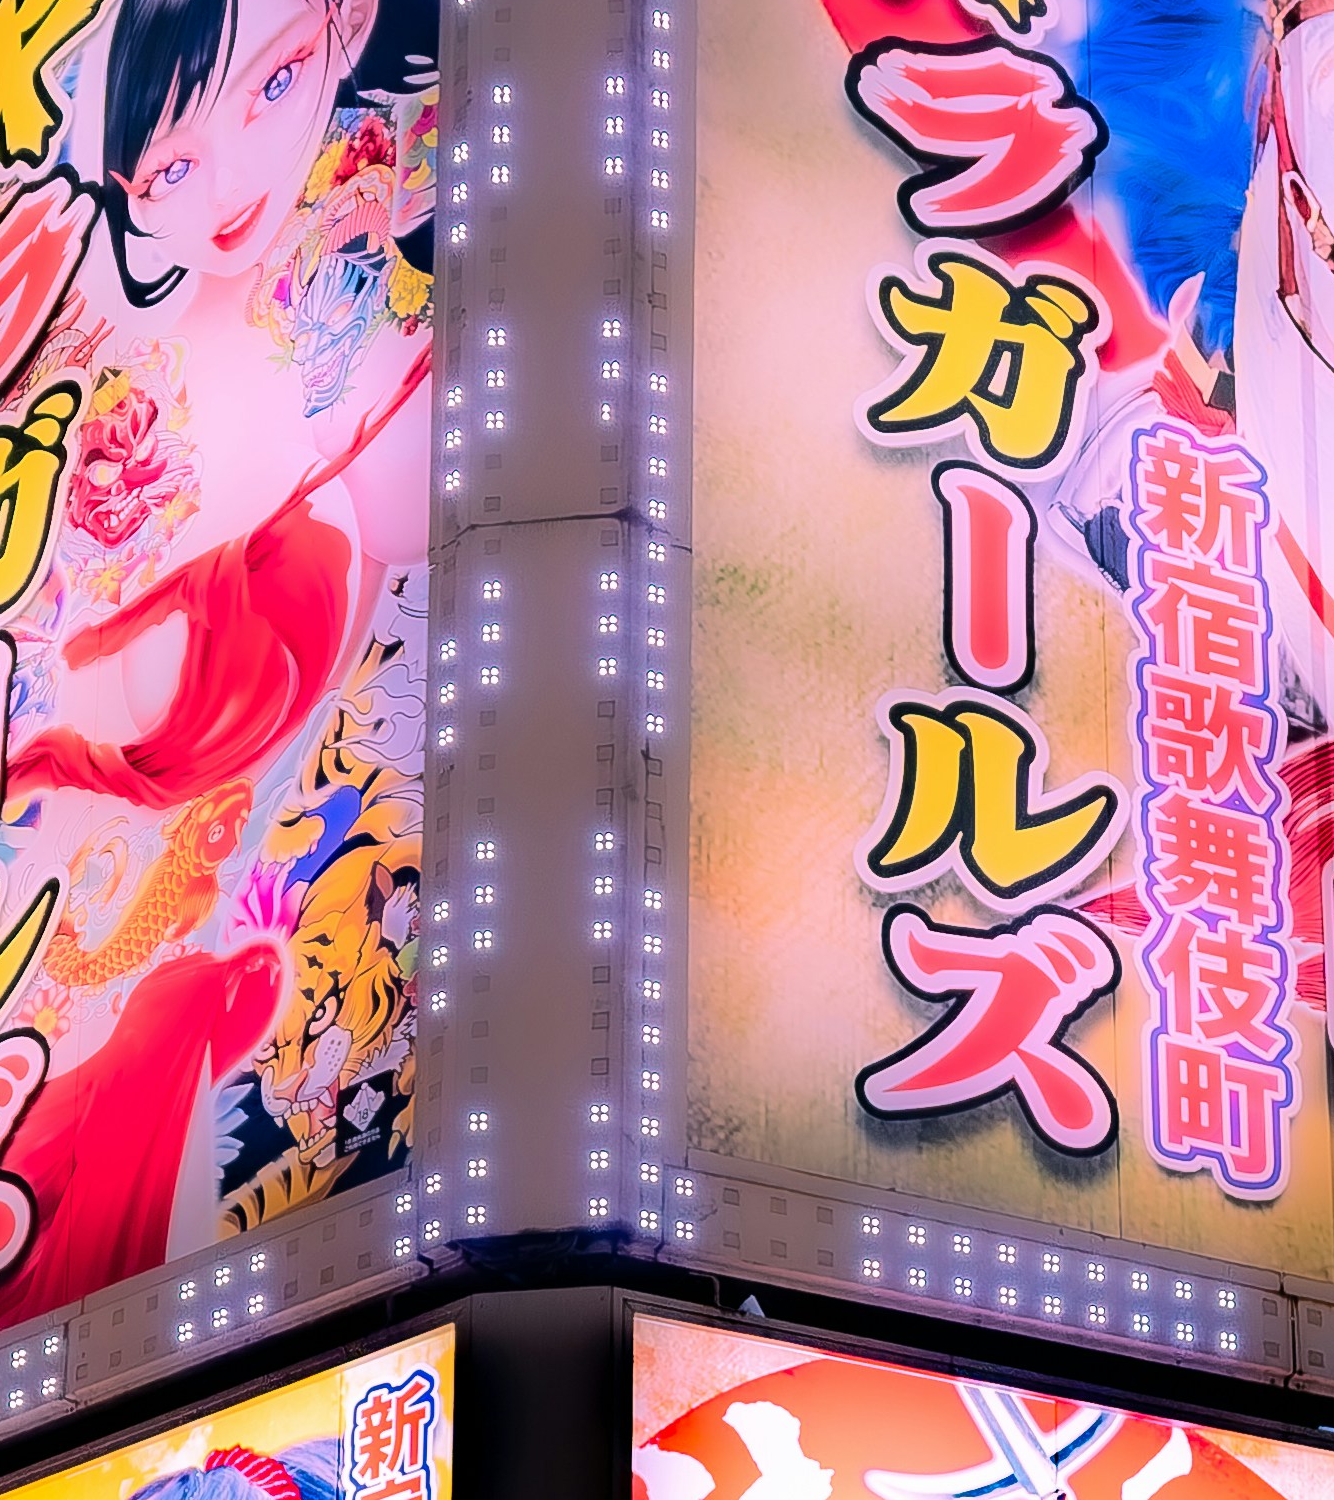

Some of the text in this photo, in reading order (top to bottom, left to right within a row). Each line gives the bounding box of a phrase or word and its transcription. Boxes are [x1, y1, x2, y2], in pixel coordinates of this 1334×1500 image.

[1130, 419, 1298, 1197] 新宿歌舞伎町
